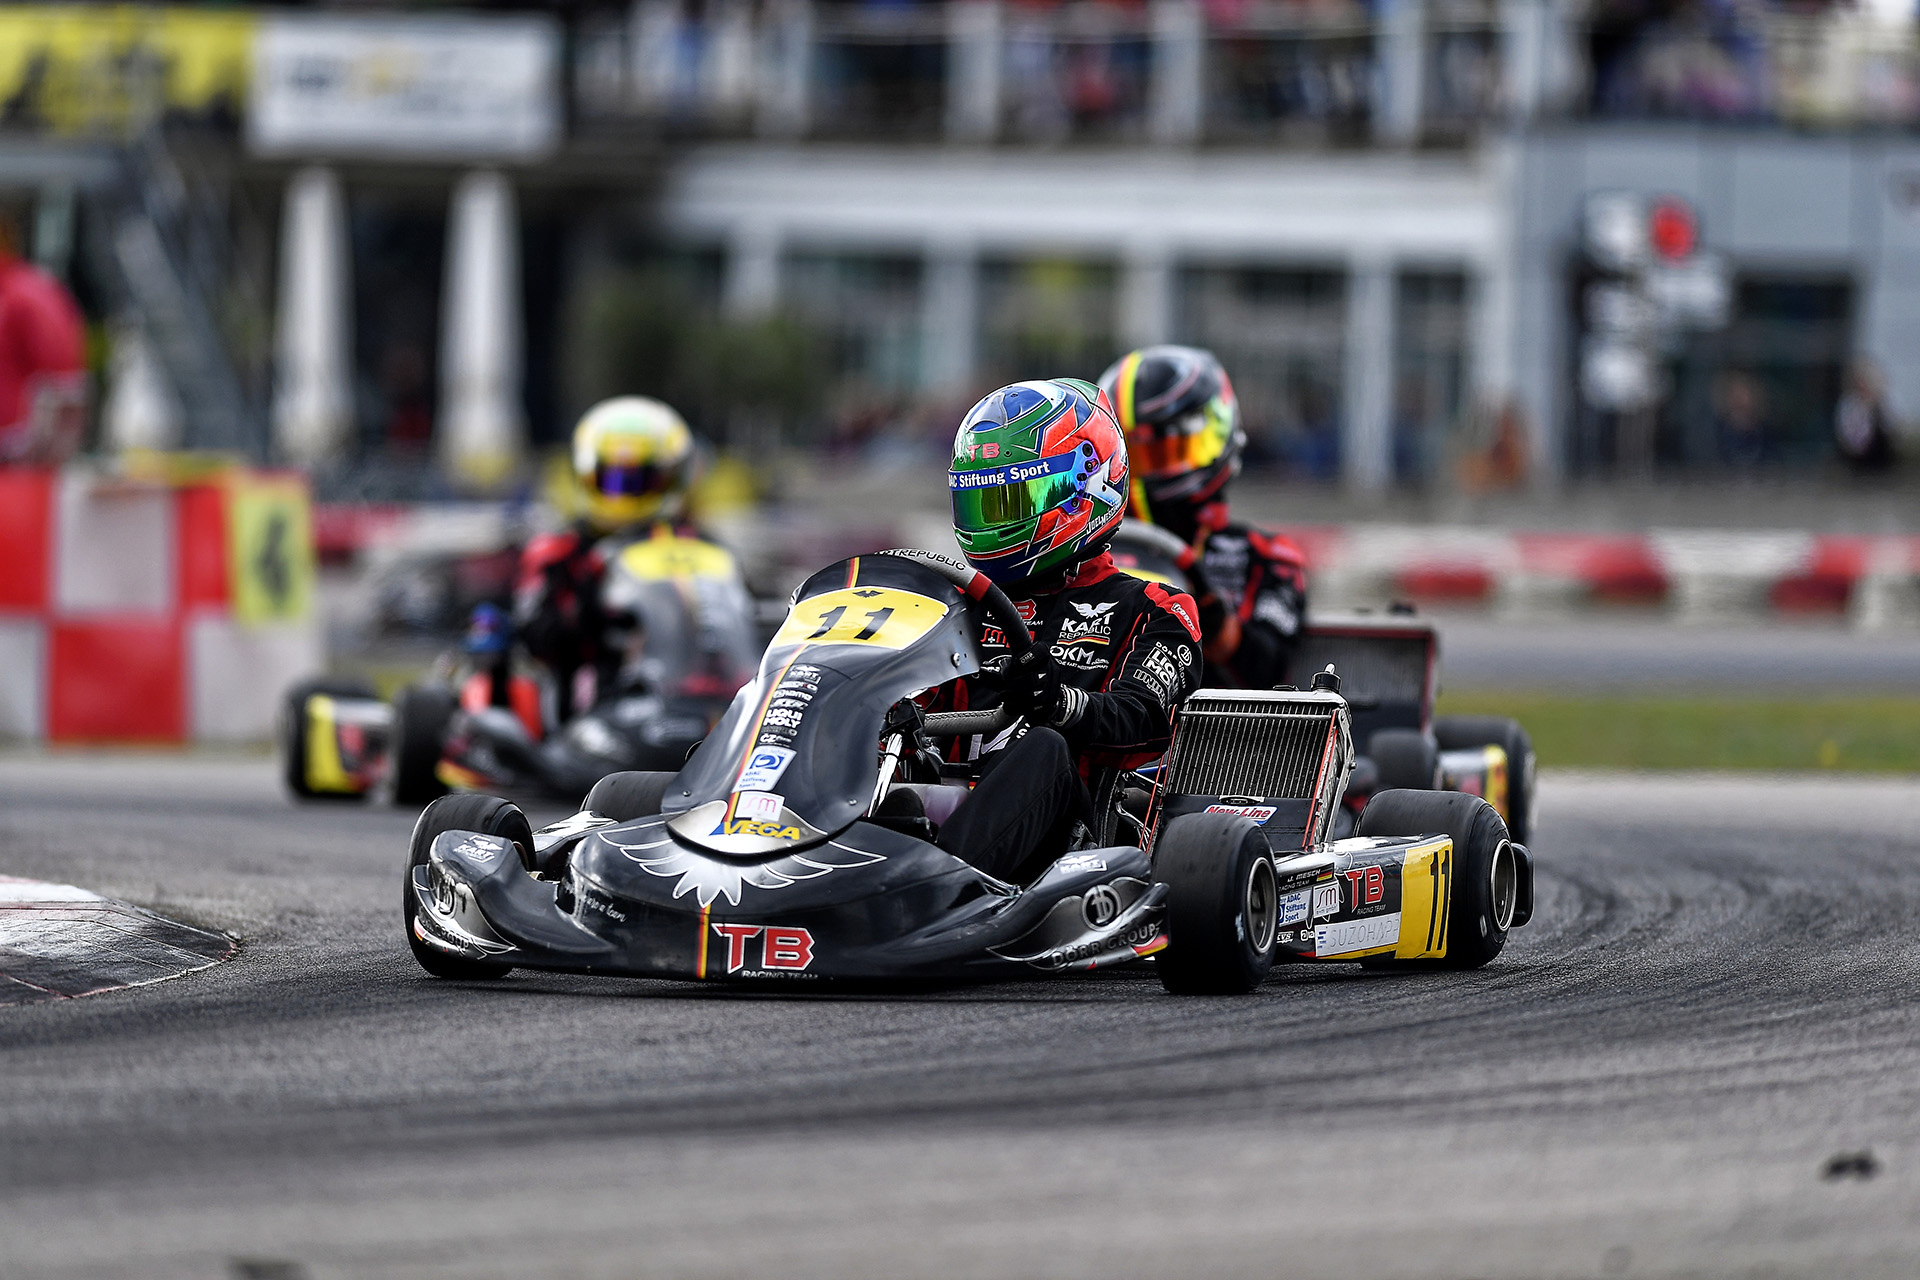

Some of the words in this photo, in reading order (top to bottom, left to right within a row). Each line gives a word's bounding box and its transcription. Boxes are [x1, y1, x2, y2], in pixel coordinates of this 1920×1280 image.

[959, 472, 1005, 488] Stiftung
[1010, 461, 1050, 480] Sport
[899, 548, 966, 571] REPUBLIC
[807, 605, 894, 641] 11
[1059, 625, 1112, 640] REPUBLIC
[1061, 612, 1114, 633] KART
[763, 716, 801, 728] MOLY
[723, 820, 800, 840] VEGA
[1296, 869, 1321, 880] MESCH
[1287, 893, 1301, 903] ADAC
[1344, 865, 1384, 913] TB
[1286, 903, 1307, 913] Stiftung
[1357, 907, 1374, 915] RACING
[1374, 904, 1387, 912] TEAM
[1425, 849, 1450, 952] 11
[1285, 912, 1299, 922] Sport
[711, 922, 815, 974] TB
[1051, 941, 1102, 966] DÖRR
[1107, 923, 1156, 949] GROUP
[741, 970, 785, 979] RACING
